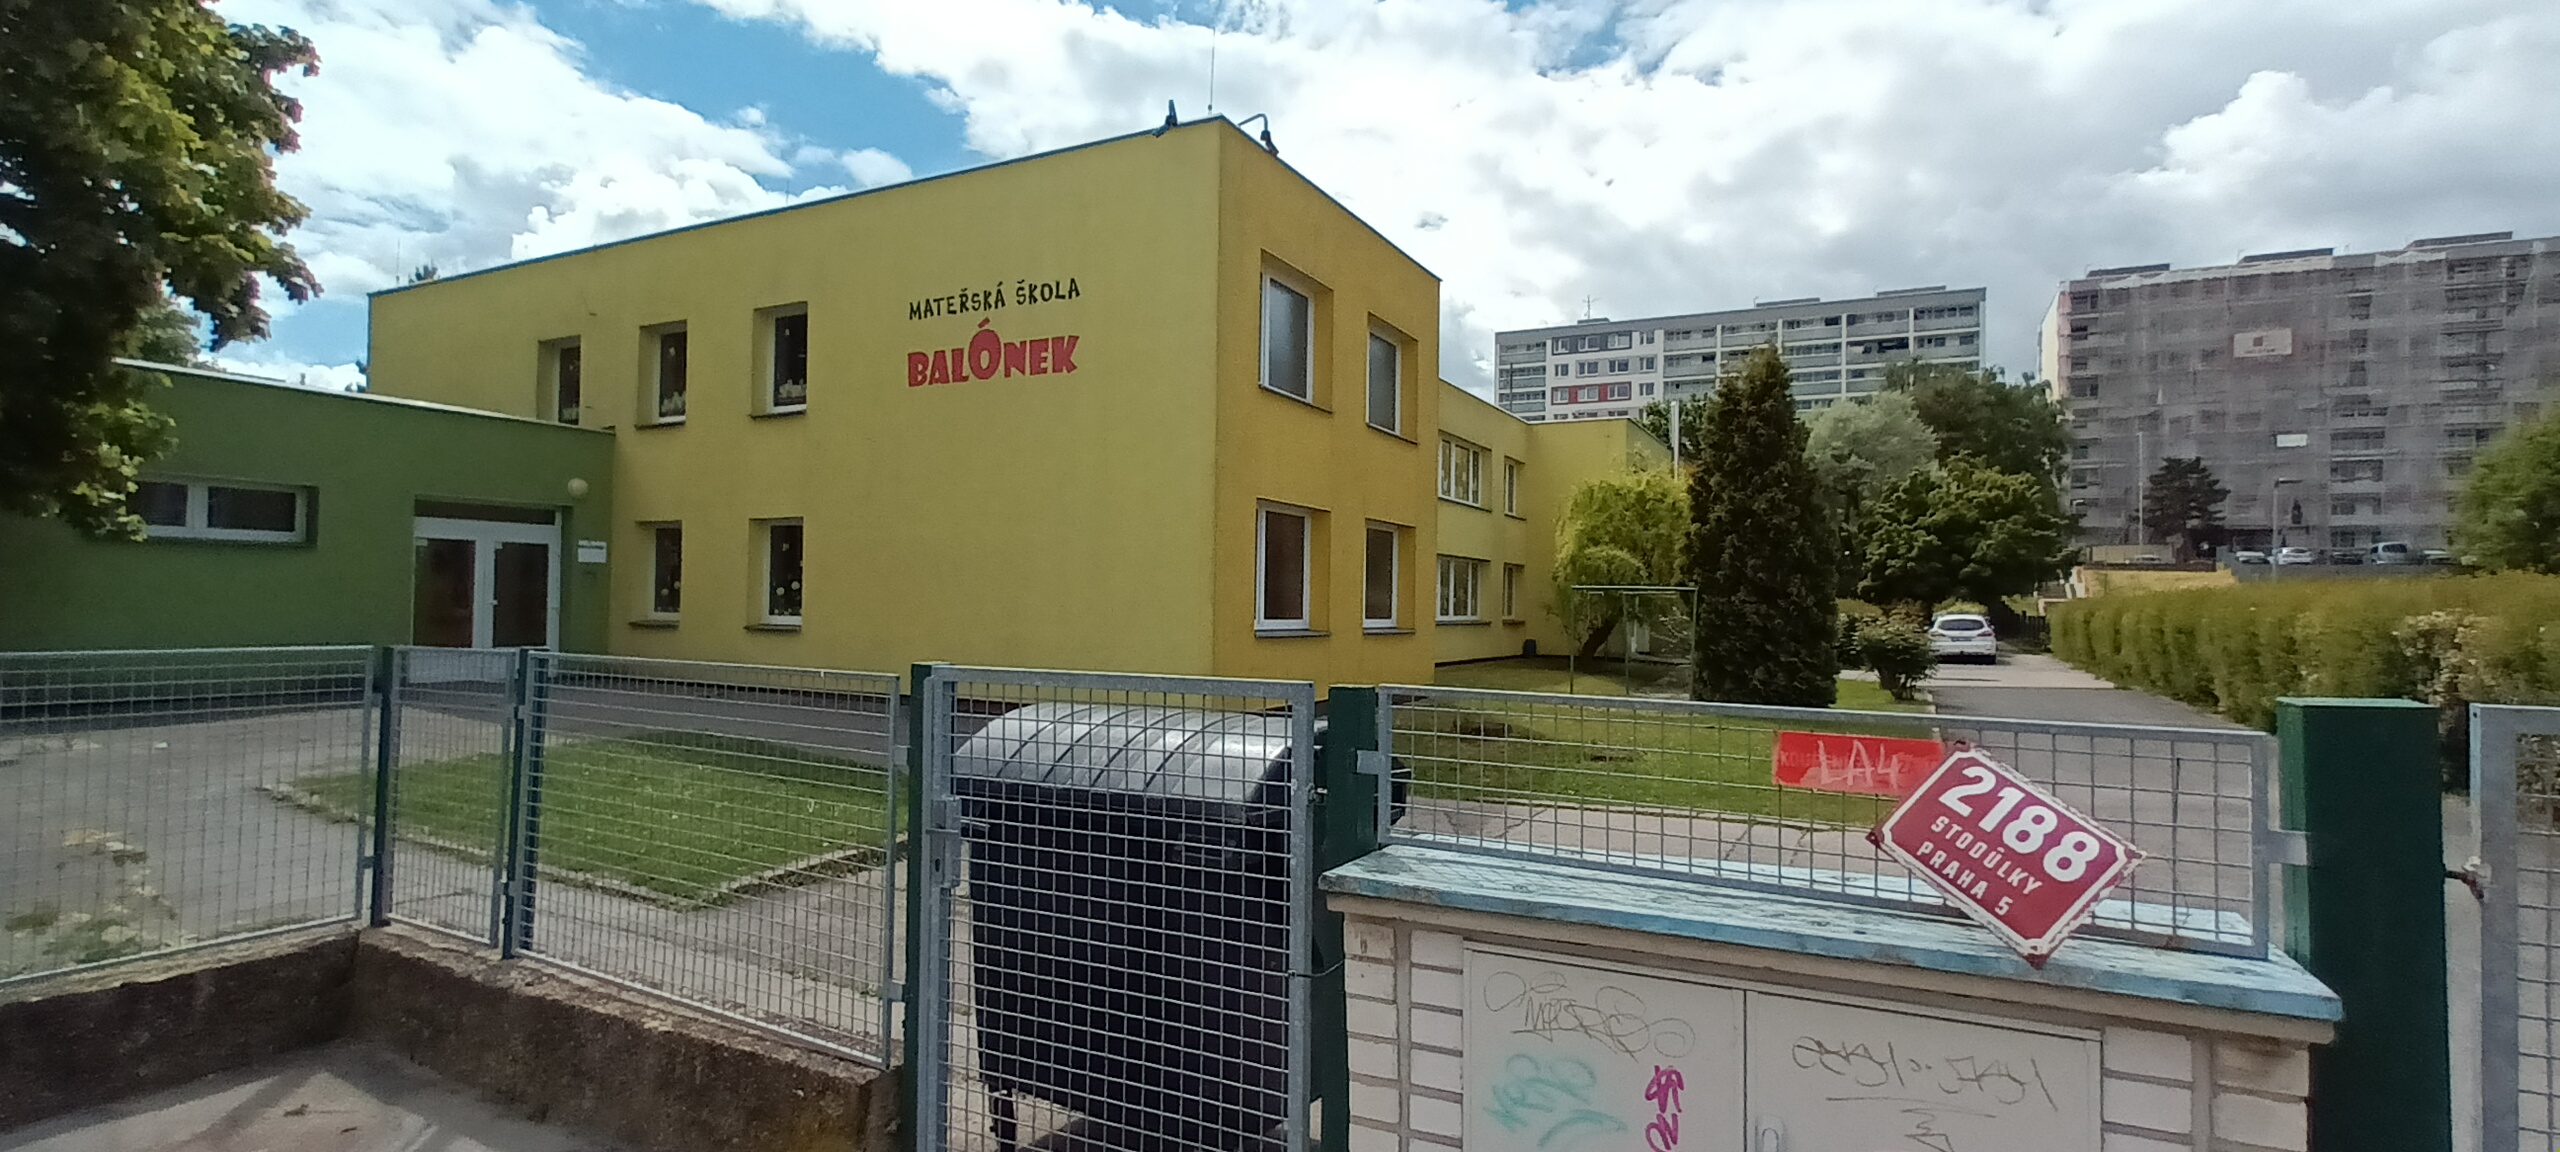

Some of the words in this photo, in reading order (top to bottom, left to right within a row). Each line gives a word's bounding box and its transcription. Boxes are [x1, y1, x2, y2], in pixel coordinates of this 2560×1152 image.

[909, 281, 1006, 320] MATEŘSKÁ
[1016, 278, 1081, 305] ŠKOLA
[907, 317, 1080, 387] BALÓNEK
[1931, 816, 2043, 895] STODŮLKY
[1938, 766, 2100, 882] 2188
[1916, 842, 1989, 899] PRAHA
[1995, 896, 2013, 915] 5
